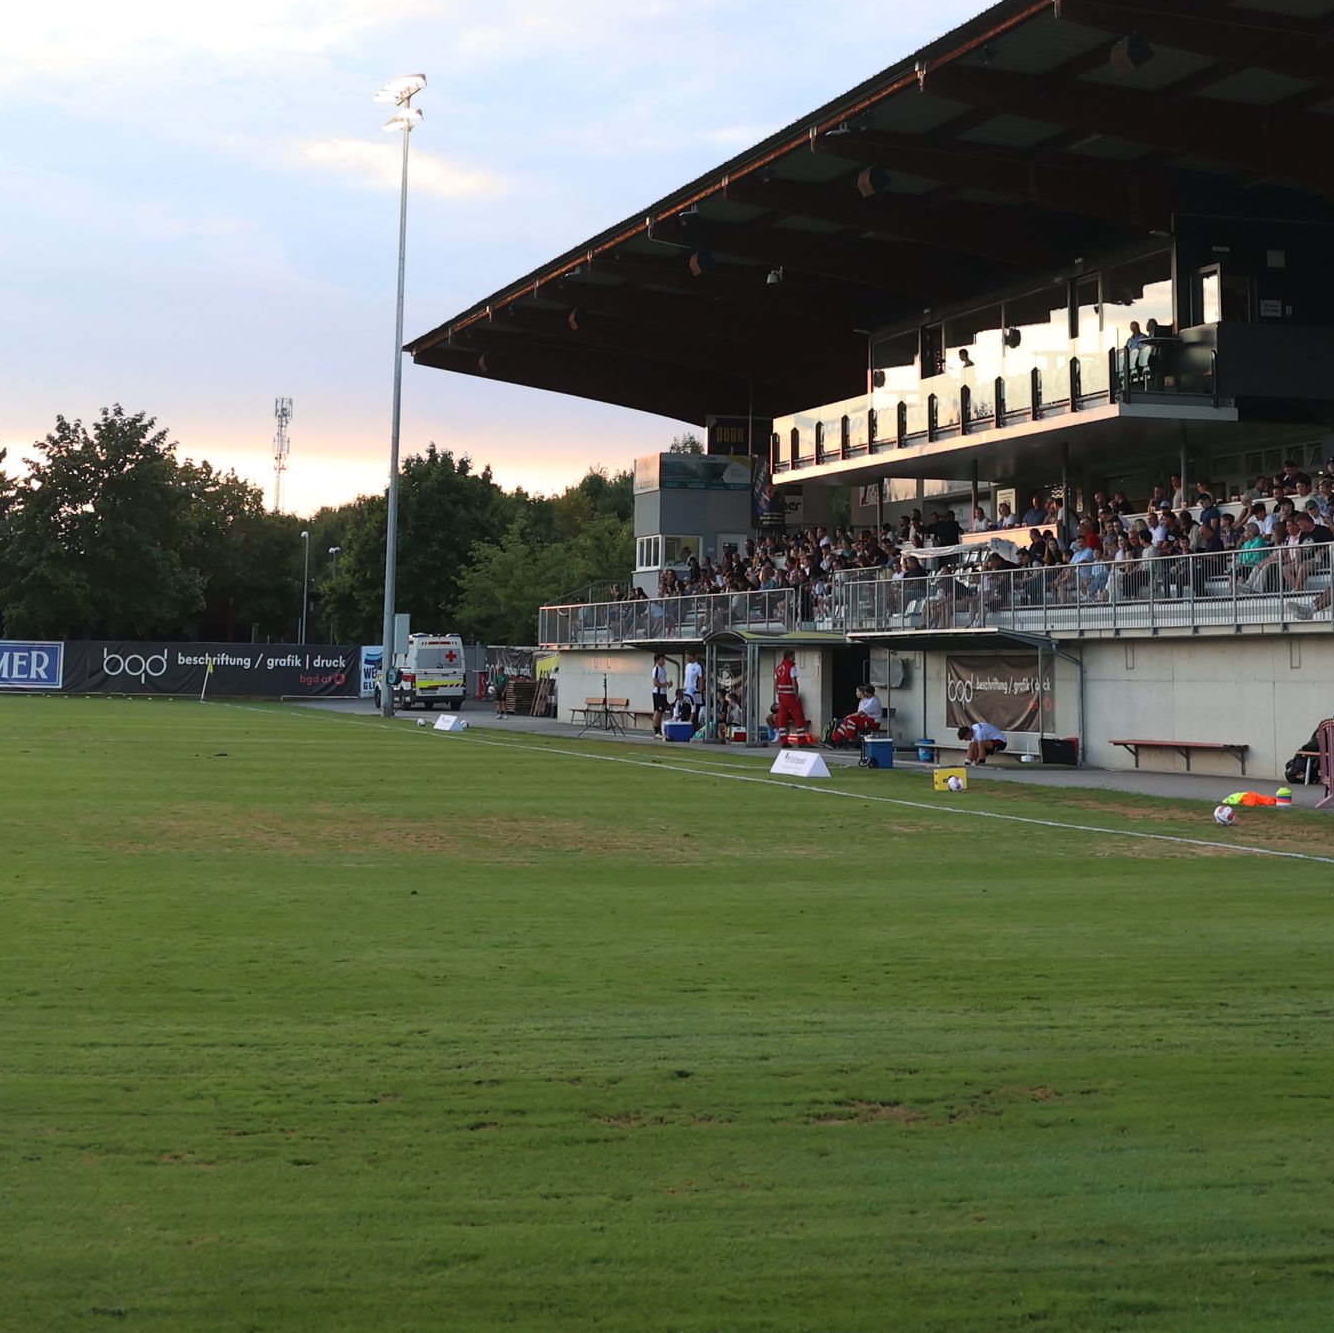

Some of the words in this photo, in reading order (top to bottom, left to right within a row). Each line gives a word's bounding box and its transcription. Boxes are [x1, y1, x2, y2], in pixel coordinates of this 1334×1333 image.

[178, 652, 251, 669] beschriftung
[266, 654, 302, 670] grafik
[313, 654, 346, 668] druck
[299, 673, 332, 685] bgd.at
[1034, 676, 1052, 691] dck
